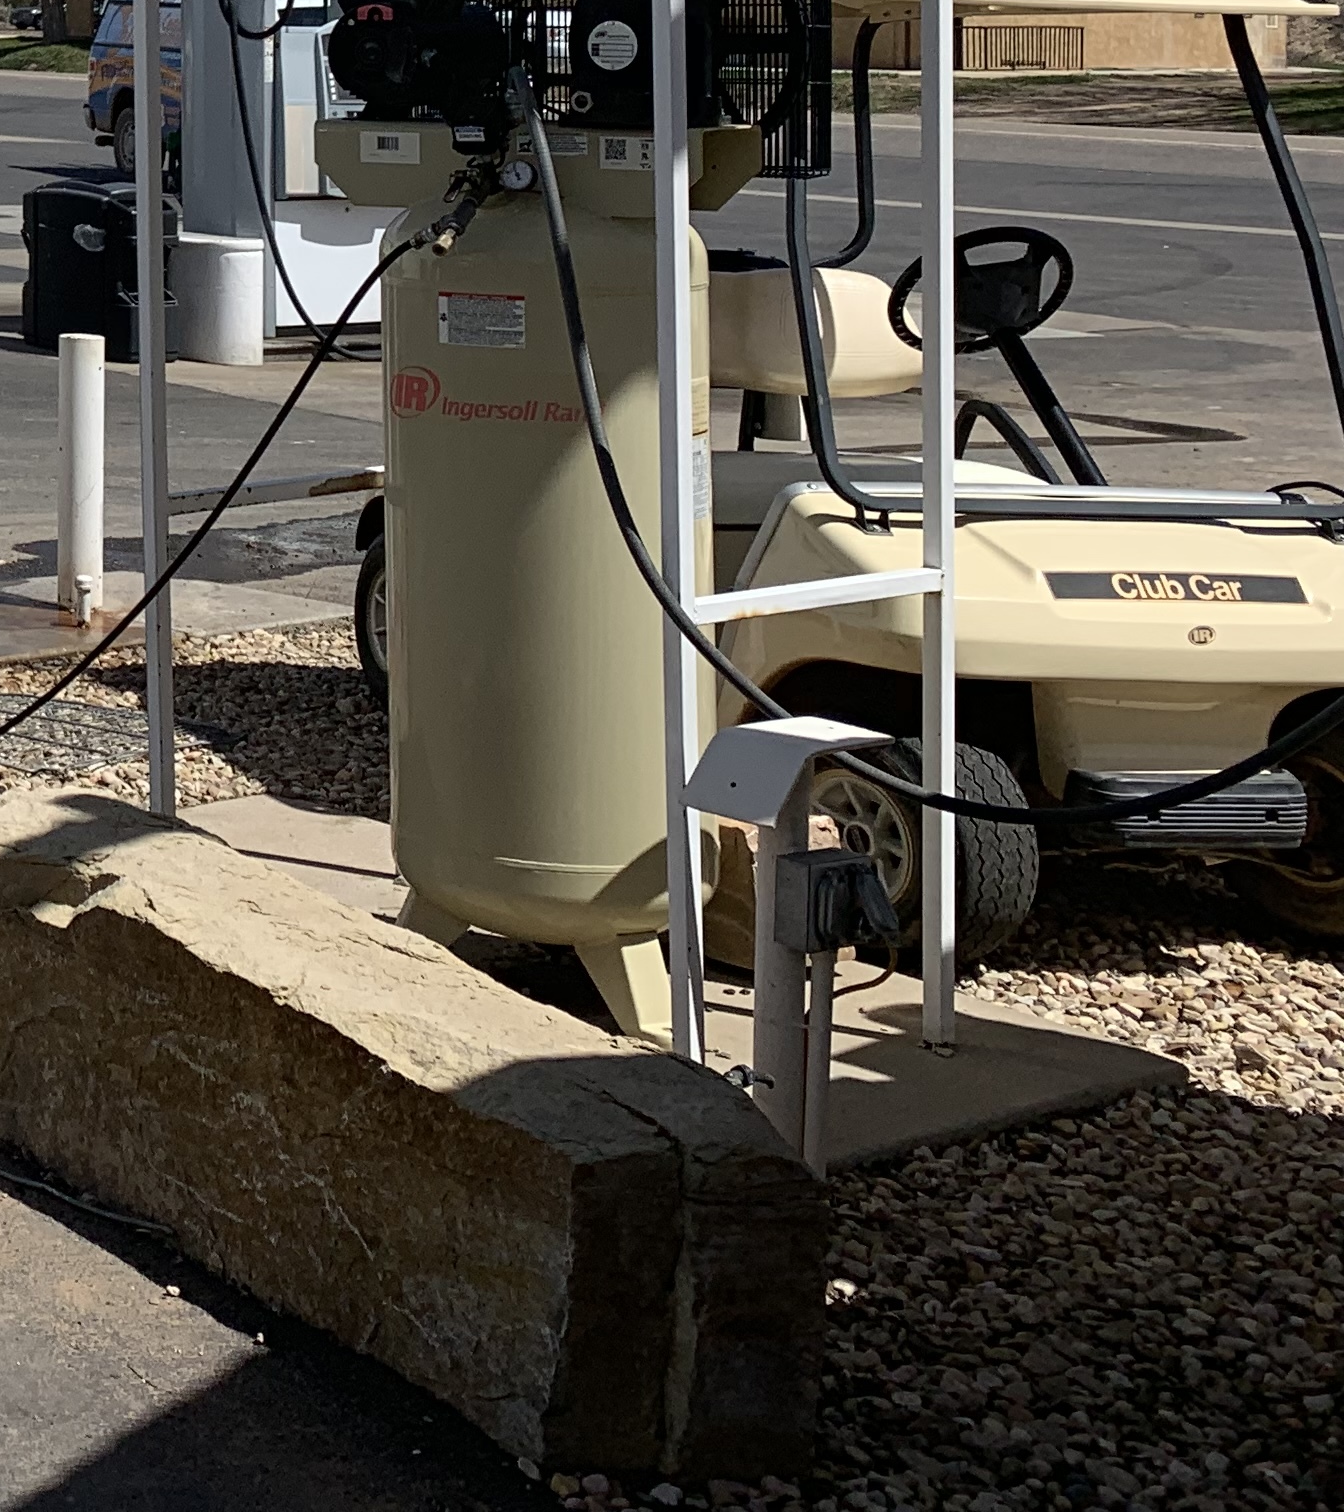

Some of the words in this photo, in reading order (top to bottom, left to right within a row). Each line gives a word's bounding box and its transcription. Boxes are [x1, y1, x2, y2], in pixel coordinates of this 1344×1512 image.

[394, 372, 430, 413] IR
[441, 396, 539, 422] Ingersoll
[1111, 572, 1186, 600] Club
[1188, 574, 1242, 601] Car
